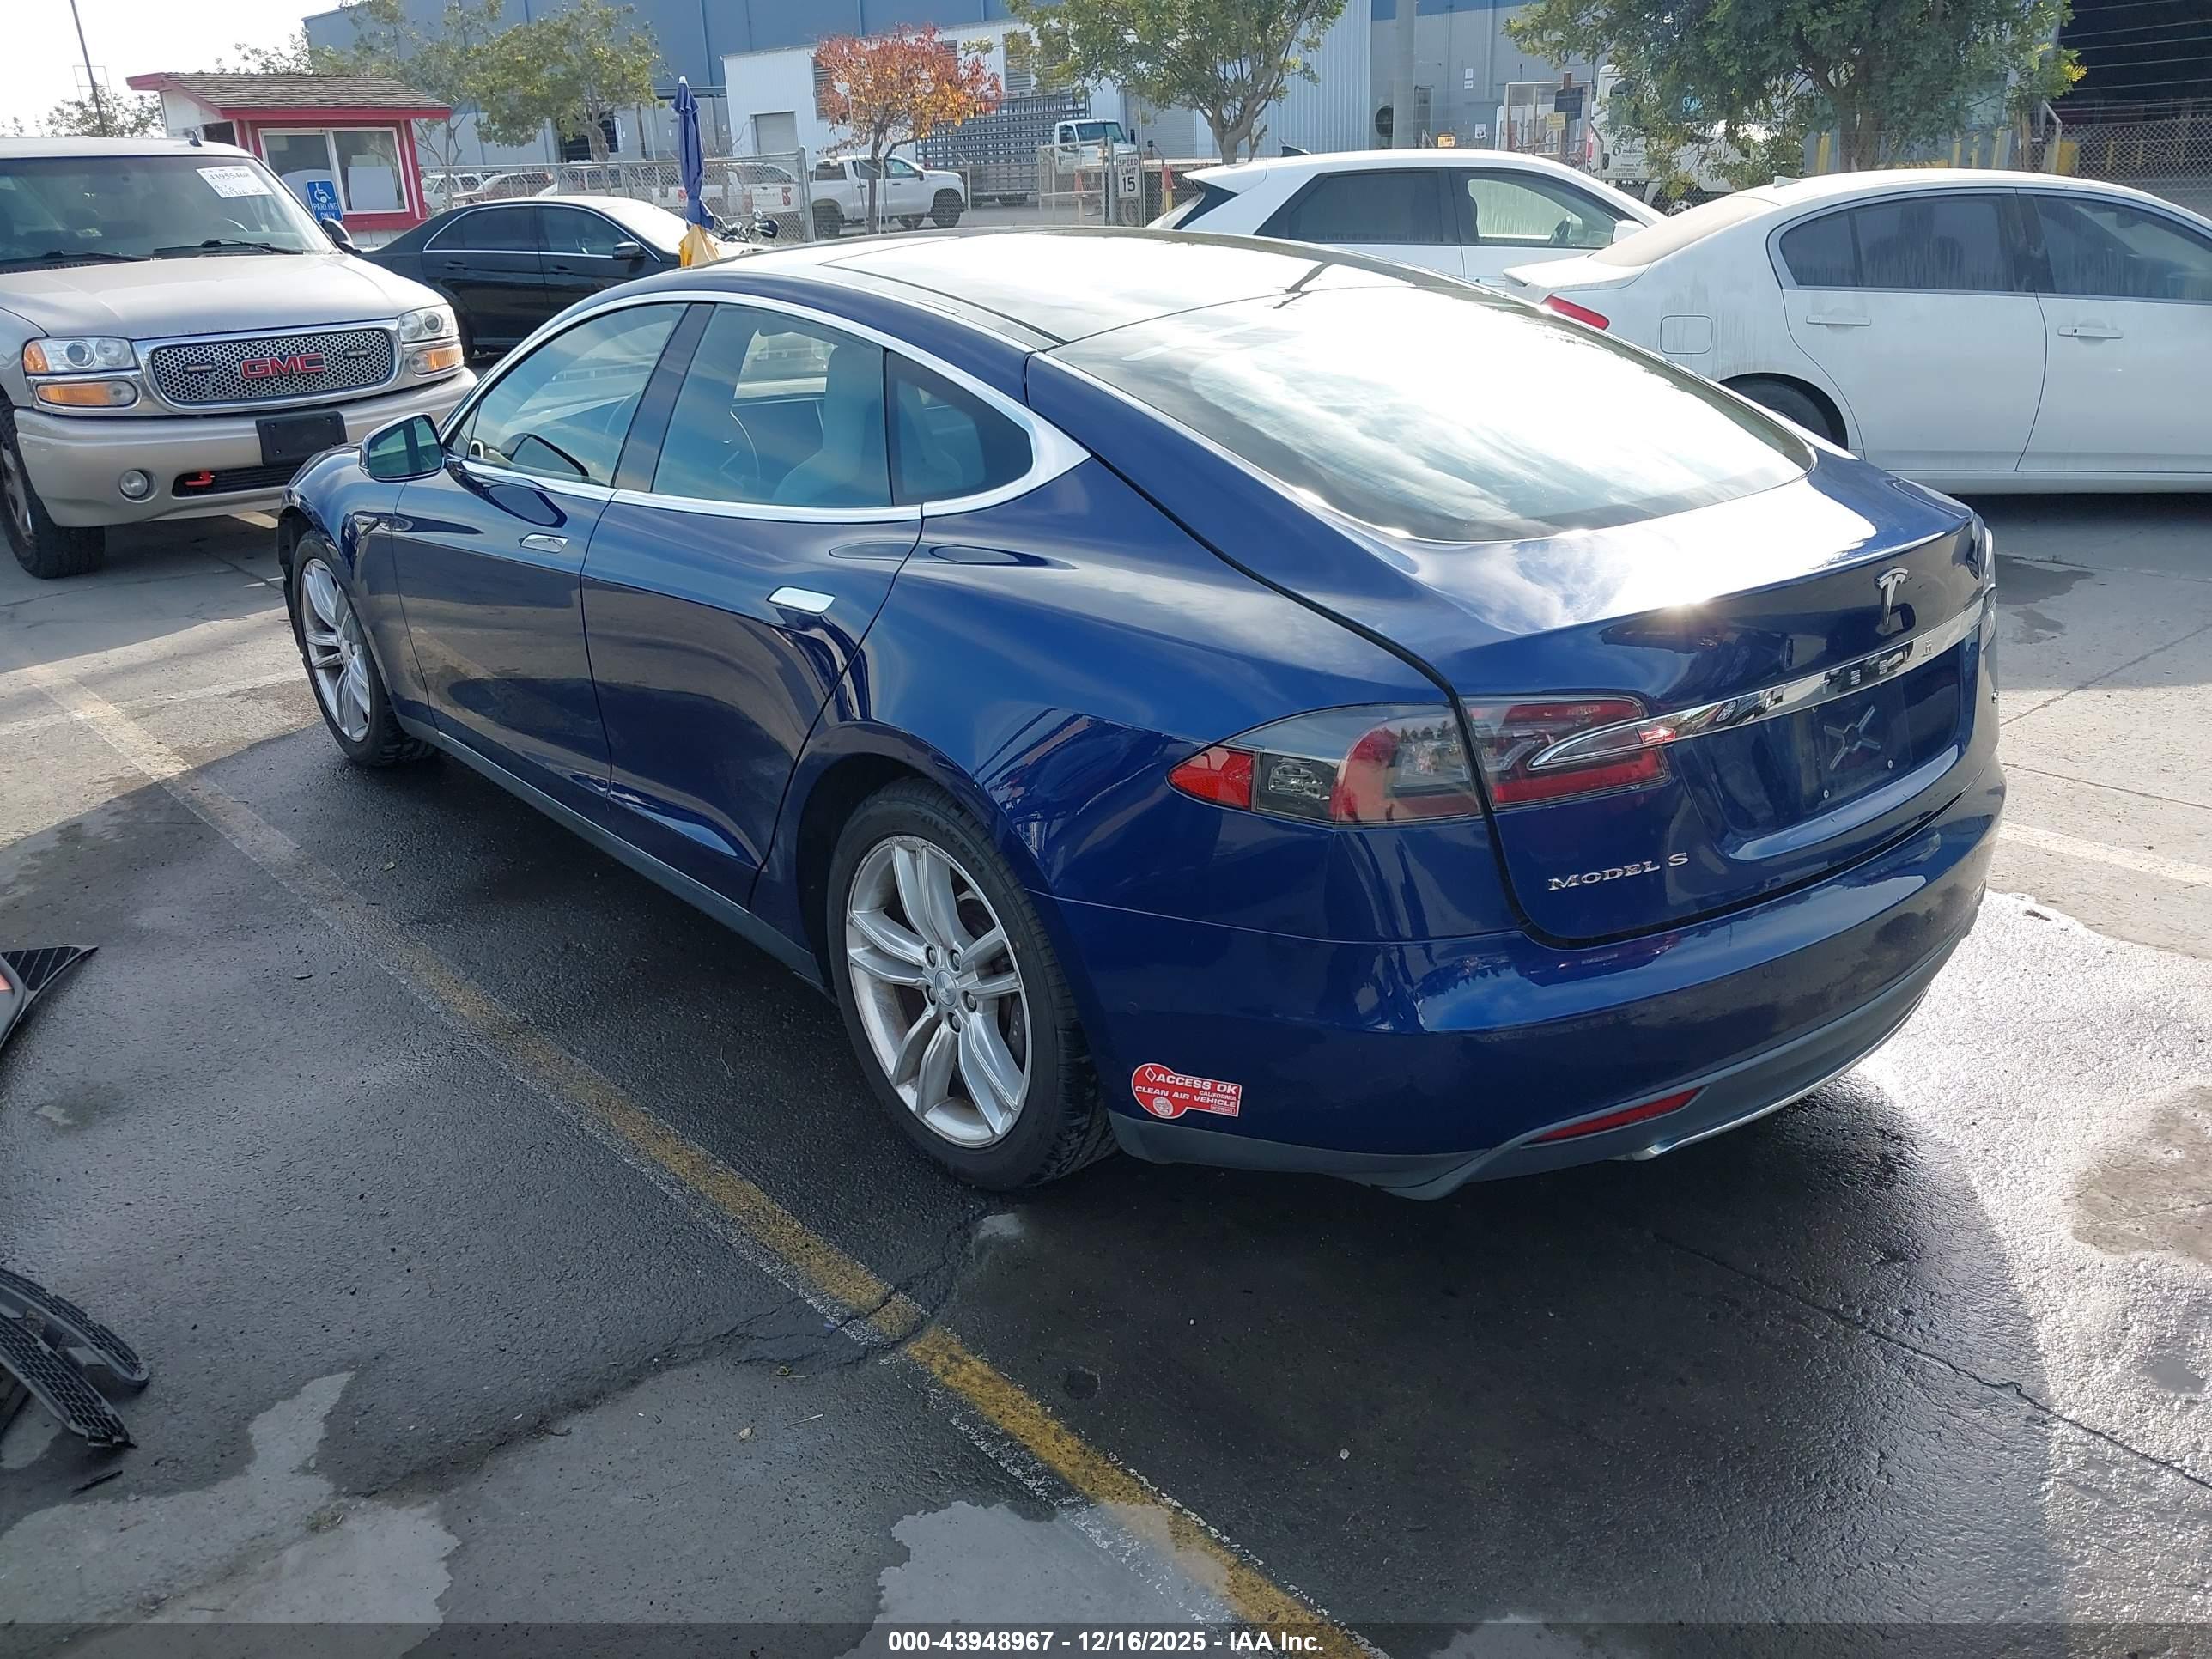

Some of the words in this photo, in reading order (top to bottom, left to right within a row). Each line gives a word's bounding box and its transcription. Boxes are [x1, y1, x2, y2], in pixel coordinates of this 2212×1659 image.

[1122, 176, 1136, 192] 15
[240, 352, 326, 380] GMC
[1548, 860, 1661, 891] MODEL
[1668, 852, 1689, 867] S
[1156, 1073, 1212, 1090] ACCESS
[1217, 1084, 1237, 1094] OK
[1135, 1085, 1169, 1097] CLEAN
[1172, 1091, 1189, 1100] AIR
[1194, 1095, 1236, 1107] VEHICLE
[1199, 1091, 1237, 1100] CALIFORNIA
